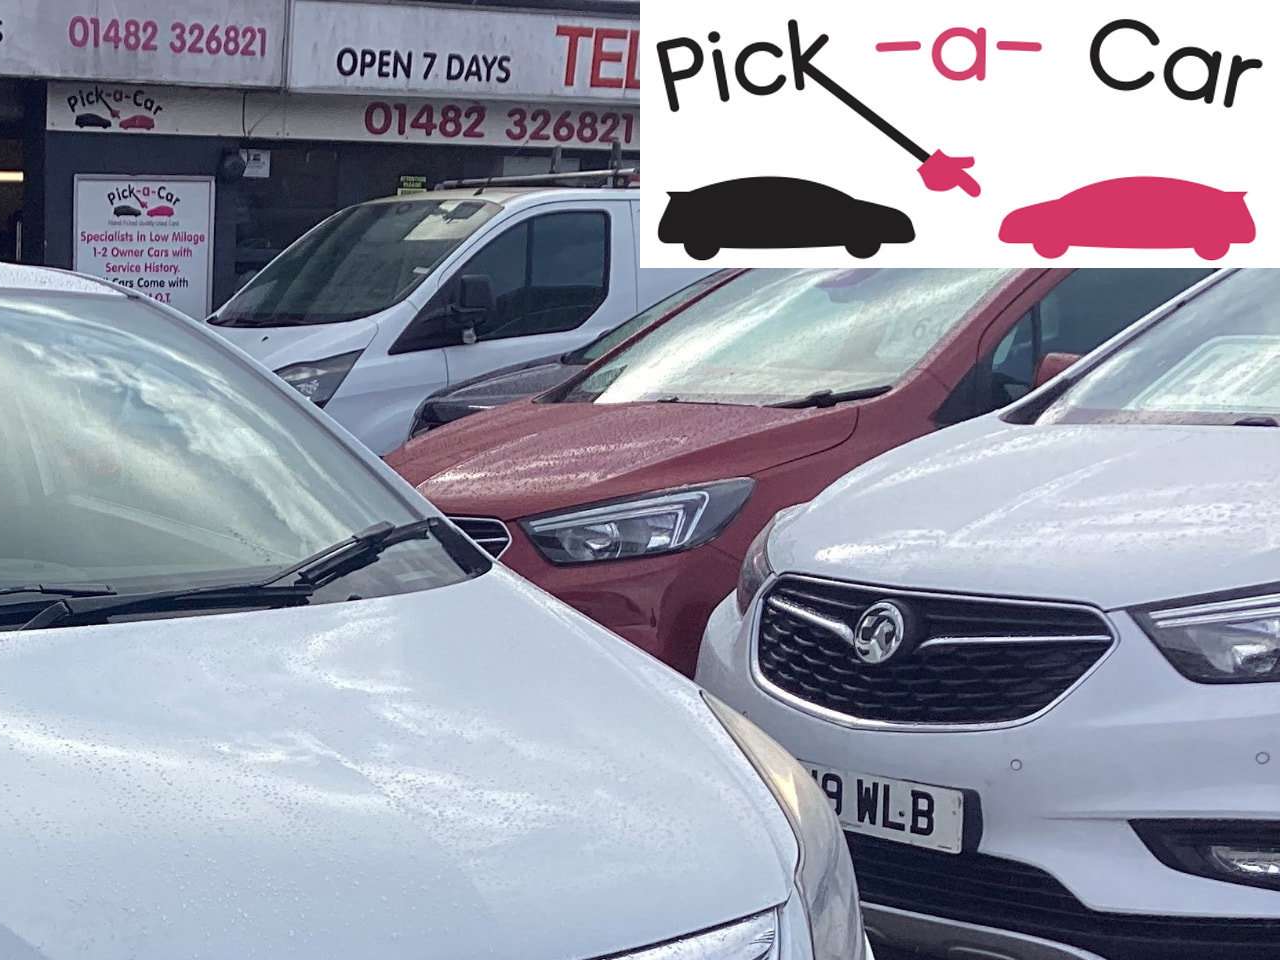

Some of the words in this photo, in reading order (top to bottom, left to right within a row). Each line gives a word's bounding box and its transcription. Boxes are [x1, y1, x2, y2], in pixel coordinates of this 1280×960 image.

[69, 15, 159, 51] 01482
[170, 22, 267, 57] 326821
[336, 47, 413, 79] OPEN
[422, 51, 438, 81] 7
[446, 53, 512, 83] DAYS
[364, 102, 488, 138] 01482
[505, 108, 634, 144] 326821
[80, 231, 133, 243] Specialists
[136, 232, 146, 241] in
[149, 232, 169, 241] Low
[171, 232, 205, 245] Milage
[93, 247, 108, 257] 1-2
[111, 247, 144, 257] Owner
[147, 247, 169, 258] Cars
[172, 247, 193, 258] with
[105, 262, 141, 273] Service
[144, 263, 181, 275] History.
[137, 277, 166, 288] Come
[168, 276, 189, 288] with
[811, 769, 843, 816] 9
[856, 778, 935, 836] WLB
